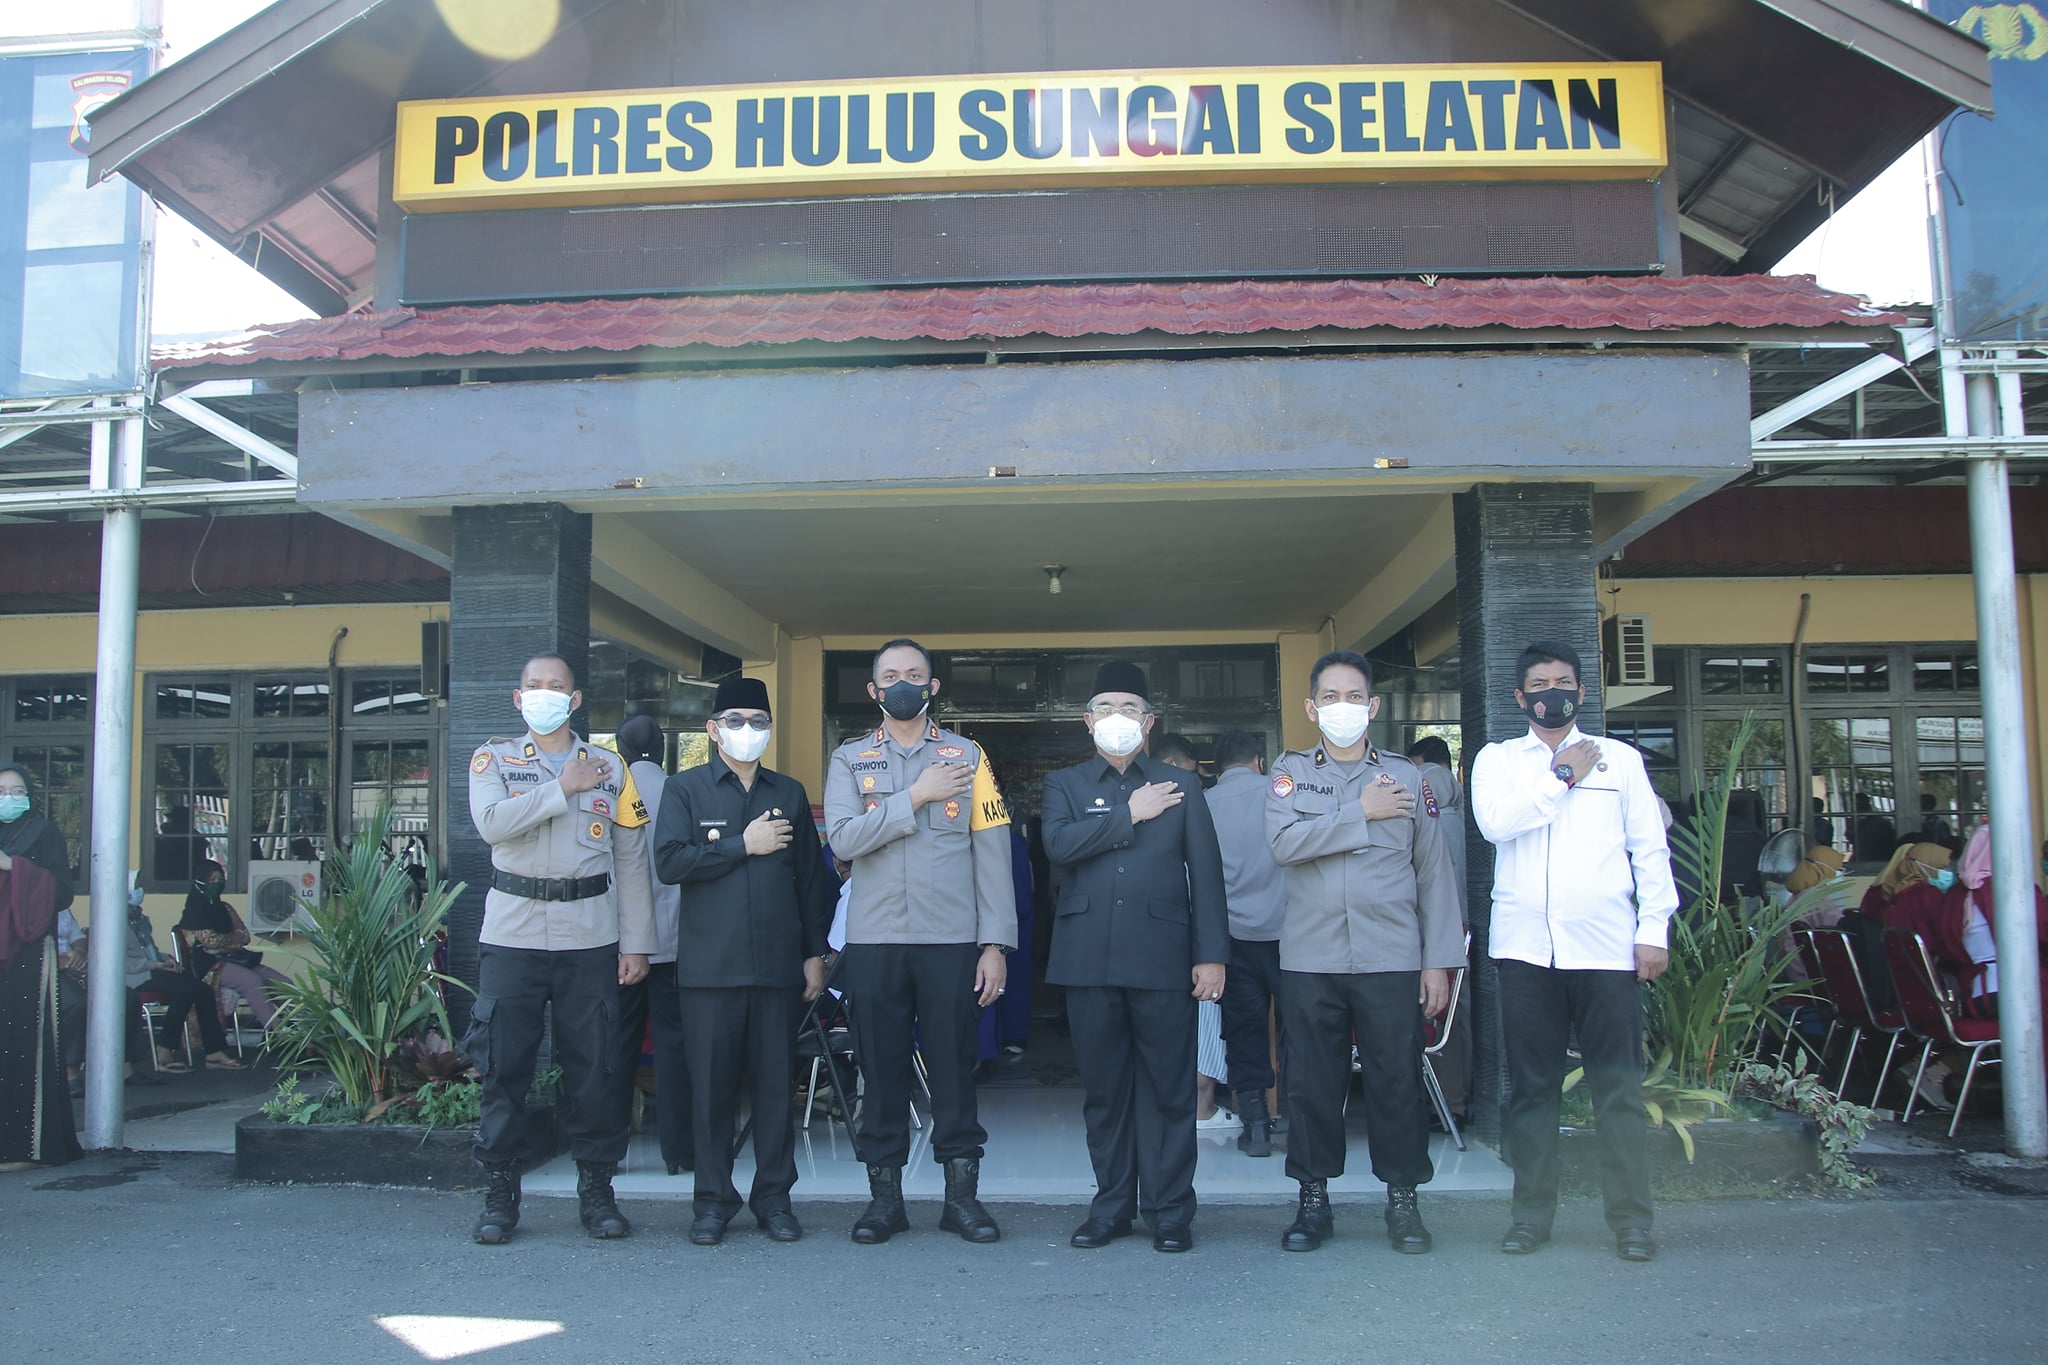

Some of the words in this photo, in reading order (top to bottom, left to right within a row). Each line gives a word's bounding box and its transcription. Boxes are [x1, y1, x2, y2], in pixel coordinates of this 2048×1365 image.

[73, 75, 105, 88] KALIMANTAN
[106, 75, 127, 85] SELATAN
[434, 100, 713, 185] POLRES
[735, 91, 935, 169] HULU
[958, 84, 1259, 162] SUNGAI
[1284, 78, 1621, 154] SELATAN
[851, 760, 888, 773] SISWOYO
[508, 772, 539, 782] RIANTO
[593, 781, 617, 795] OLRI
[1297, 782, 1334, 795] RUSLAN
